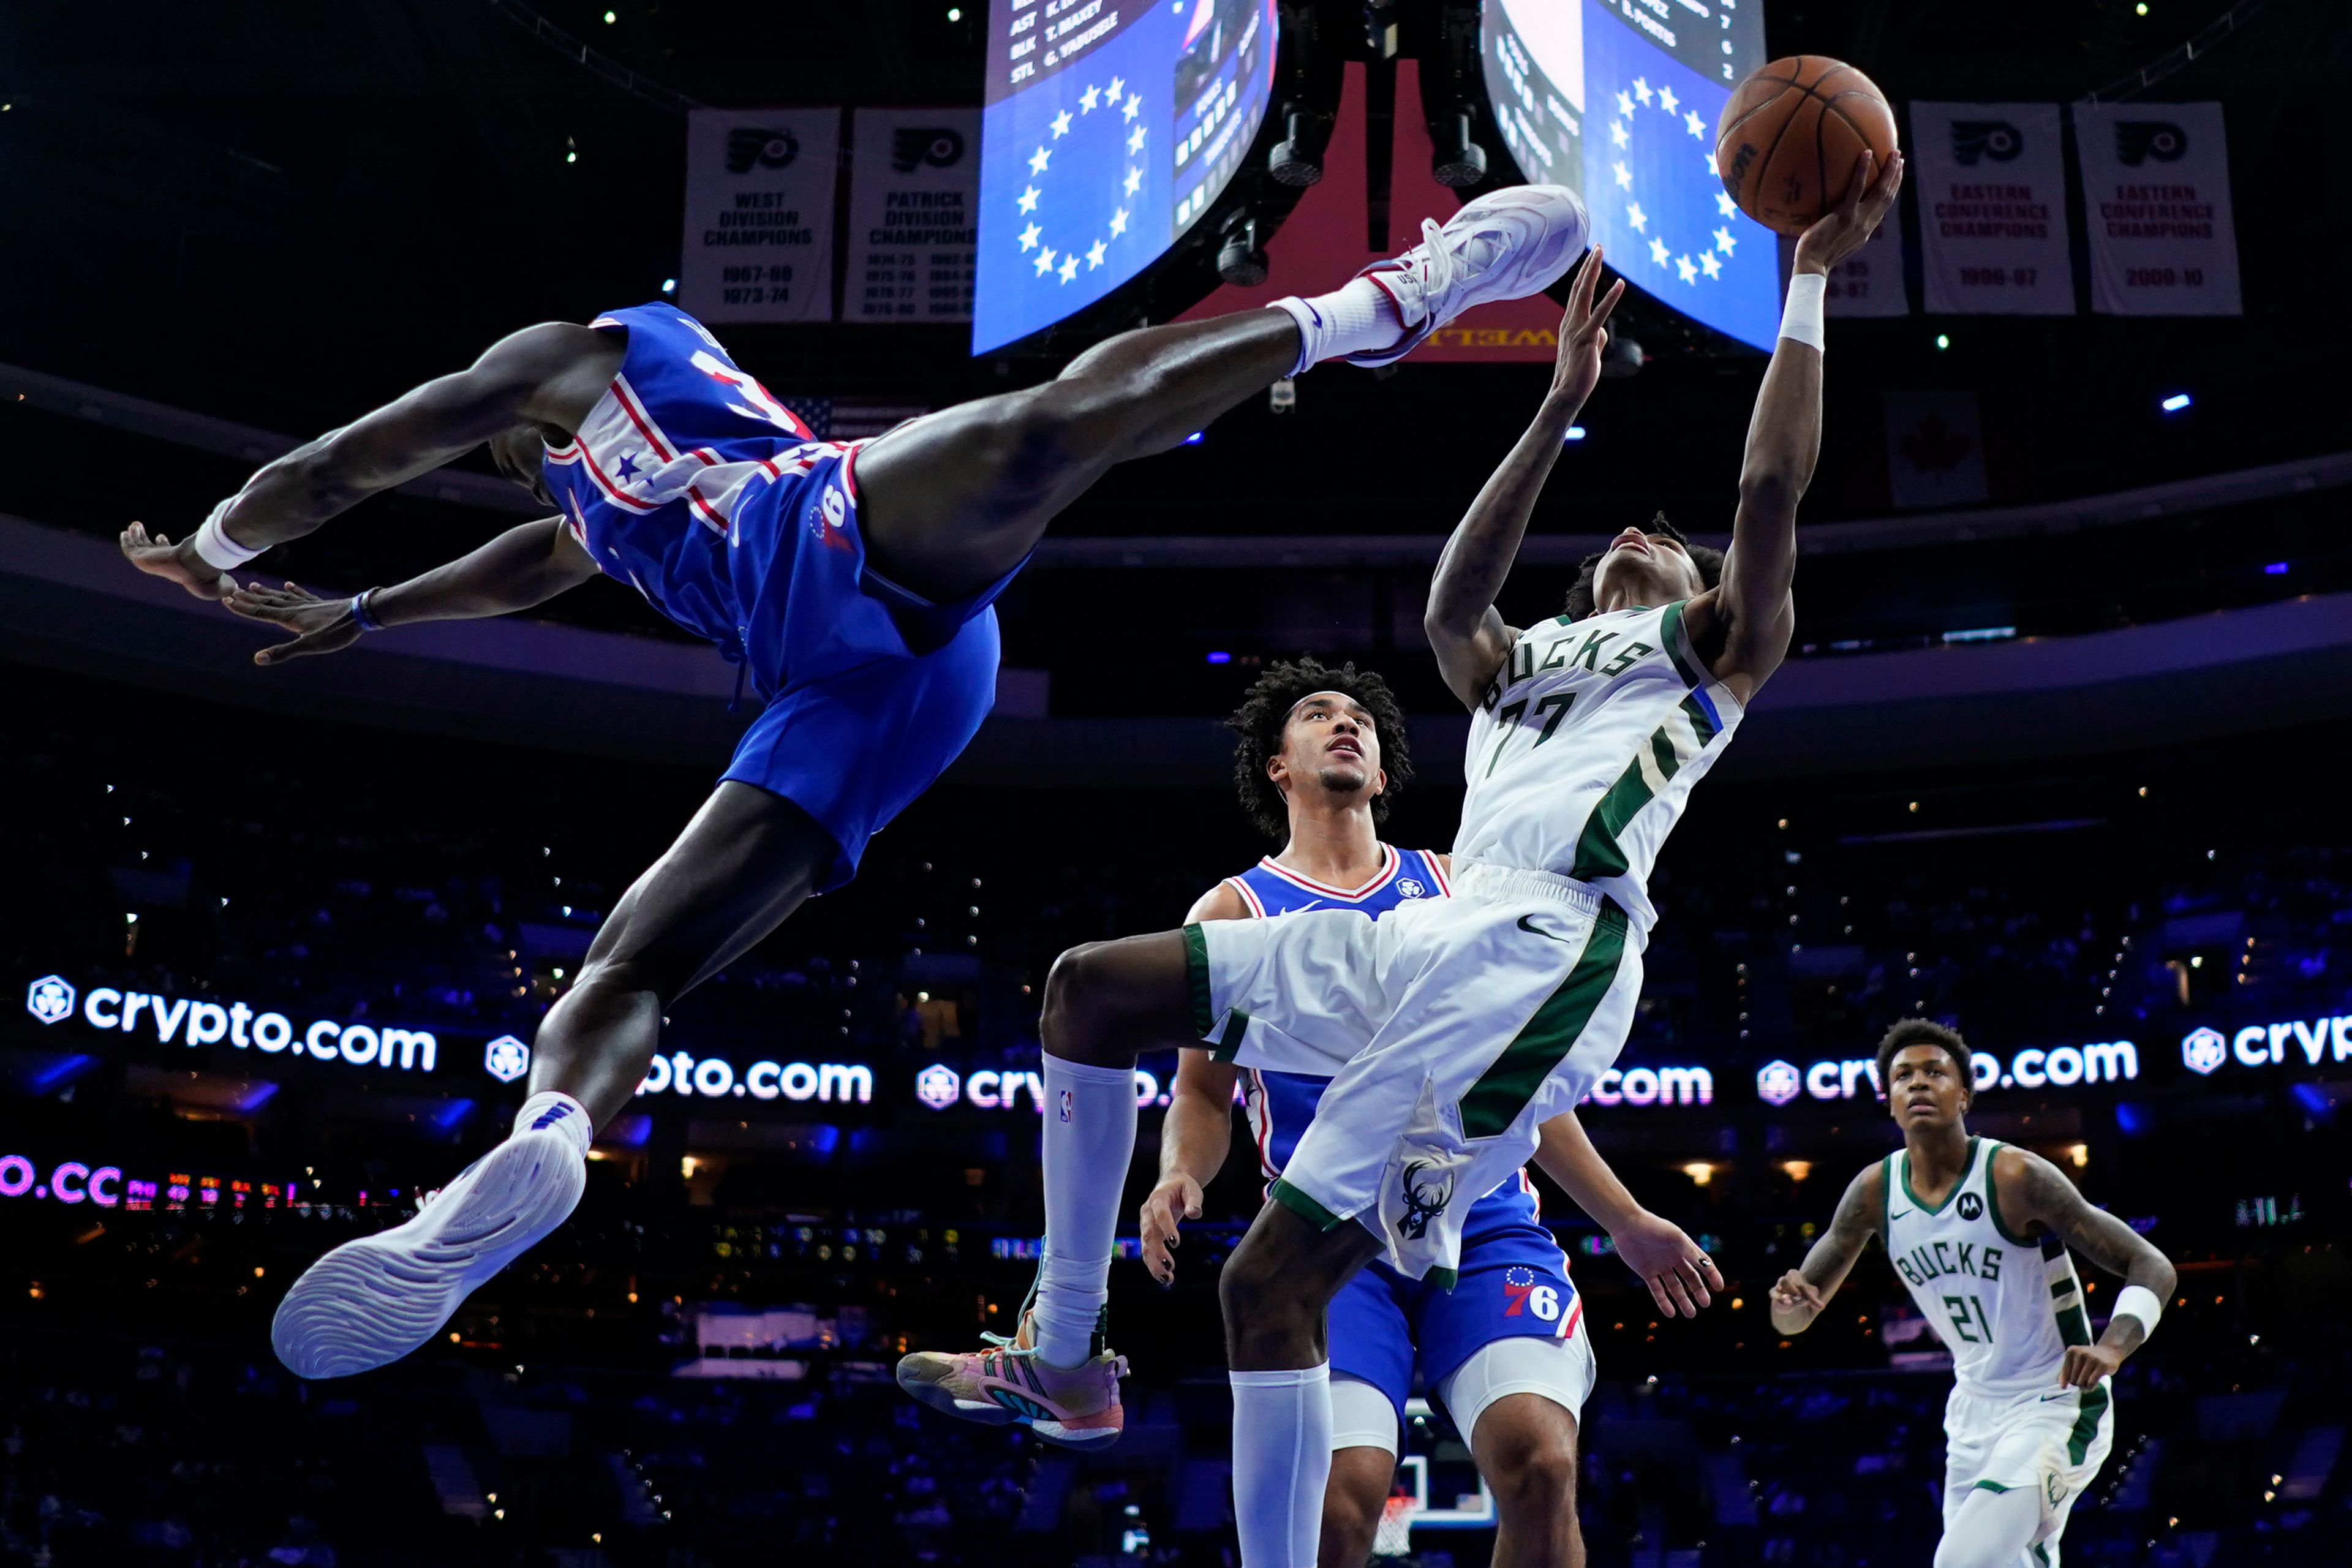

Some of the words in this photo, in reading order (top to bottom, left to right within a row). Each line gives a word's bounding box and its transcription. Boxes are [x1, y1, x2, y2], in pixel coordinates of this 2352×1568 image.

[1009, 11, 1038, 36] AST
[1010, 36, 1037, 60] BLK
[1721, 40, 1733, 55] 6
[1010, 61, 1035, 84] STL
[1722, 63, 1733, 80] 2
[736, 193, 783, 207] WEST
[887, 192, 963, 206] PATRICK
[1952, 185, 2030, 200] EASTERN
[2116, 185, 2195, 200] EASTERN
[720, 212, 798, 226] DIVISION
[886, 211, 963, 225] DIVISION
[1936, 203, 2048, 219] CONFERENCE
[2100, 203, 2213, 219] CONFERENCE
[704, 229, 812, 245] CHAMPIONS
[1940, 222, 2048, 238] CHAMPIONS
[2107, 222, 2212, 238] CHAMPIONS
[724, 288, 789, 304] 1973-74
[1485, 692, 1578, 779] 77
[84, 987, 437, 1072] crypto.com
[636, 1050, 873, 1105] pto.com
[1896, 1242, 2002, 1287] BUCKS
[1504, 1283, 1559, 1322] 76
[1943, 1295, 1994, 1344] 21
